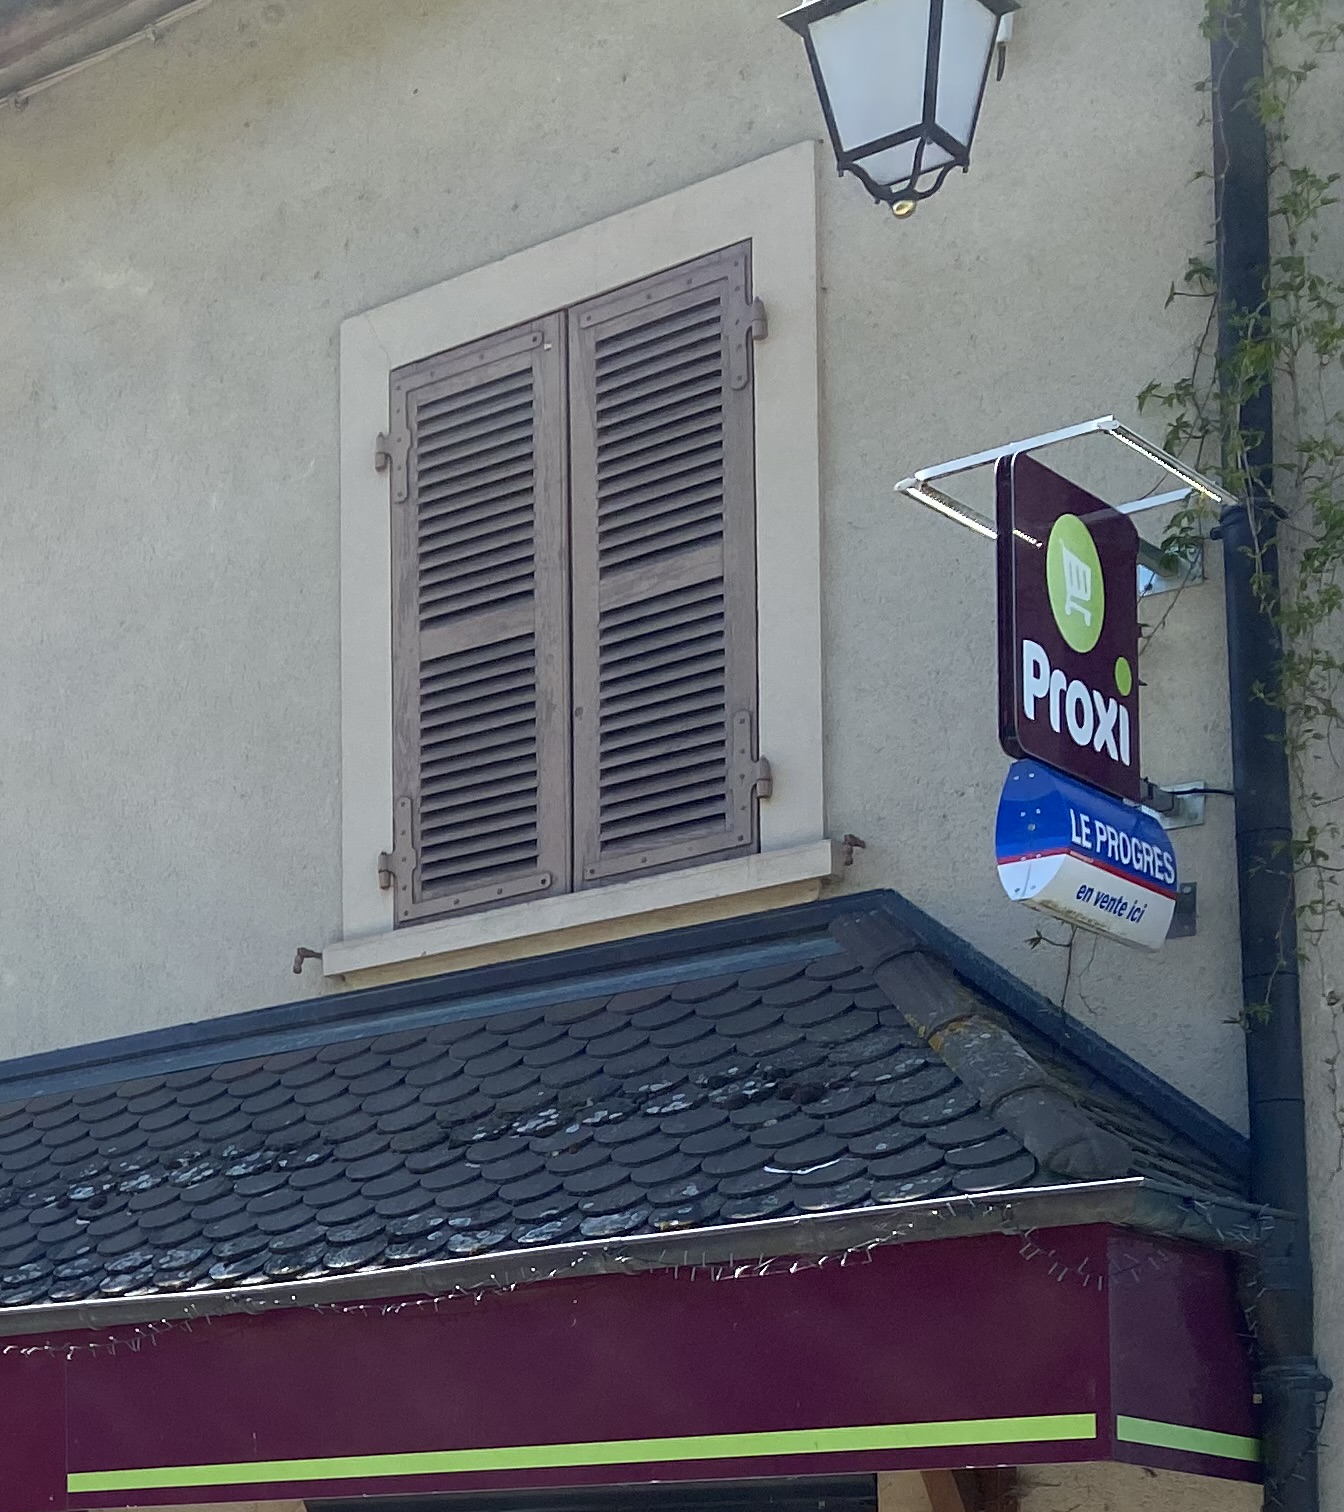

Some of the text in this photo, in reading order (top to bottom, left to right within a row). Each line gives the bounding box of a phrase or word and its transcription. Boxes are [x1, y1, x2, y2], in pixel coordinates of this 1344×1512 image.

[1069, 808, 1175, 884] LE PROGRES
[1076, 884, 1148, 924] en vente ici
